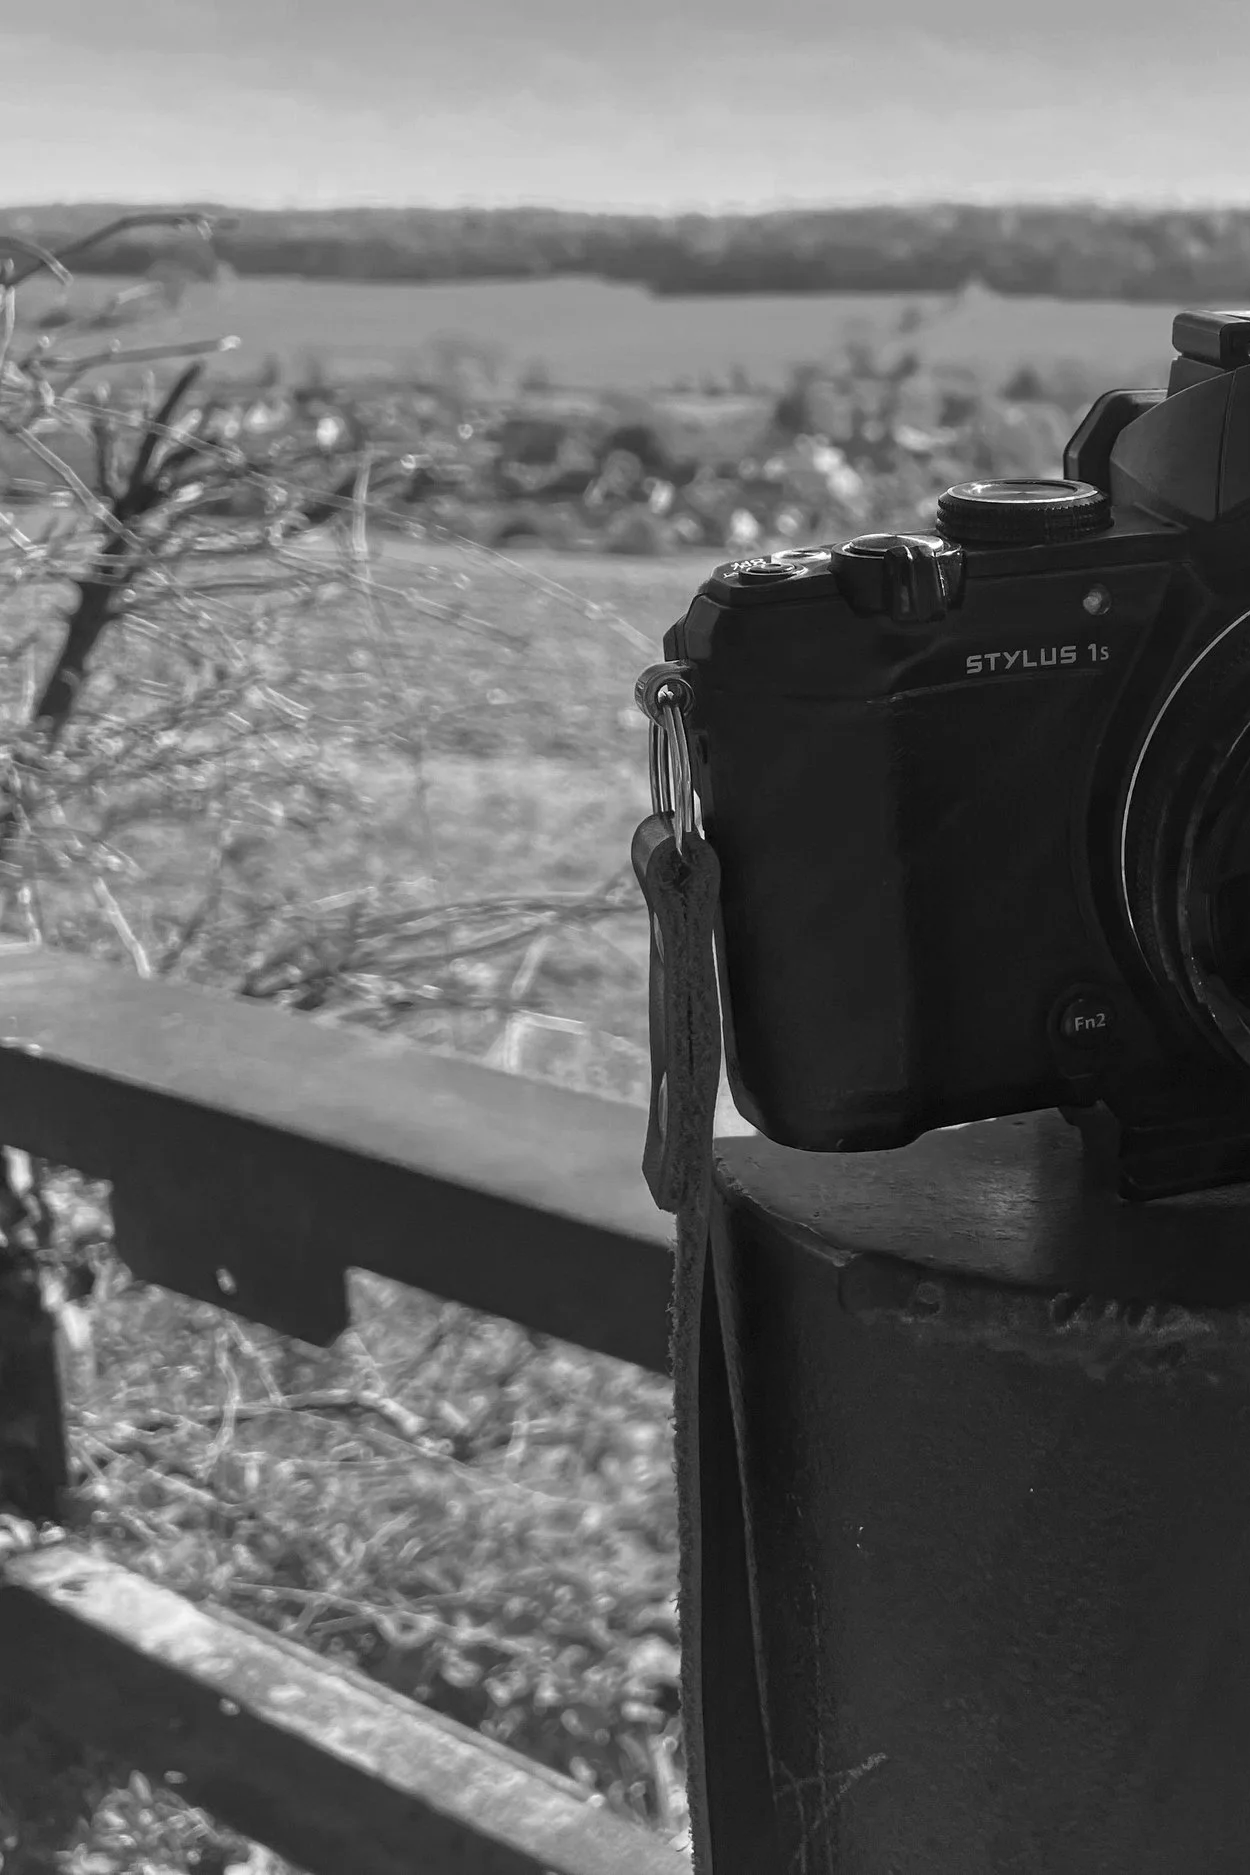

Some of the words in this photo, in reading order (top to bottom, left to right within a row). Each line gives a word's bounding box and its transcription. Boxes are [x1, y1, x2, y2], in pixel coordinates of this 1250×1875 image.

[966, 645, 1077, 674] STYLUS
[1087, 643, 1110, 662] 1s
[1074, 1012, 1106, 1032] Fn2
